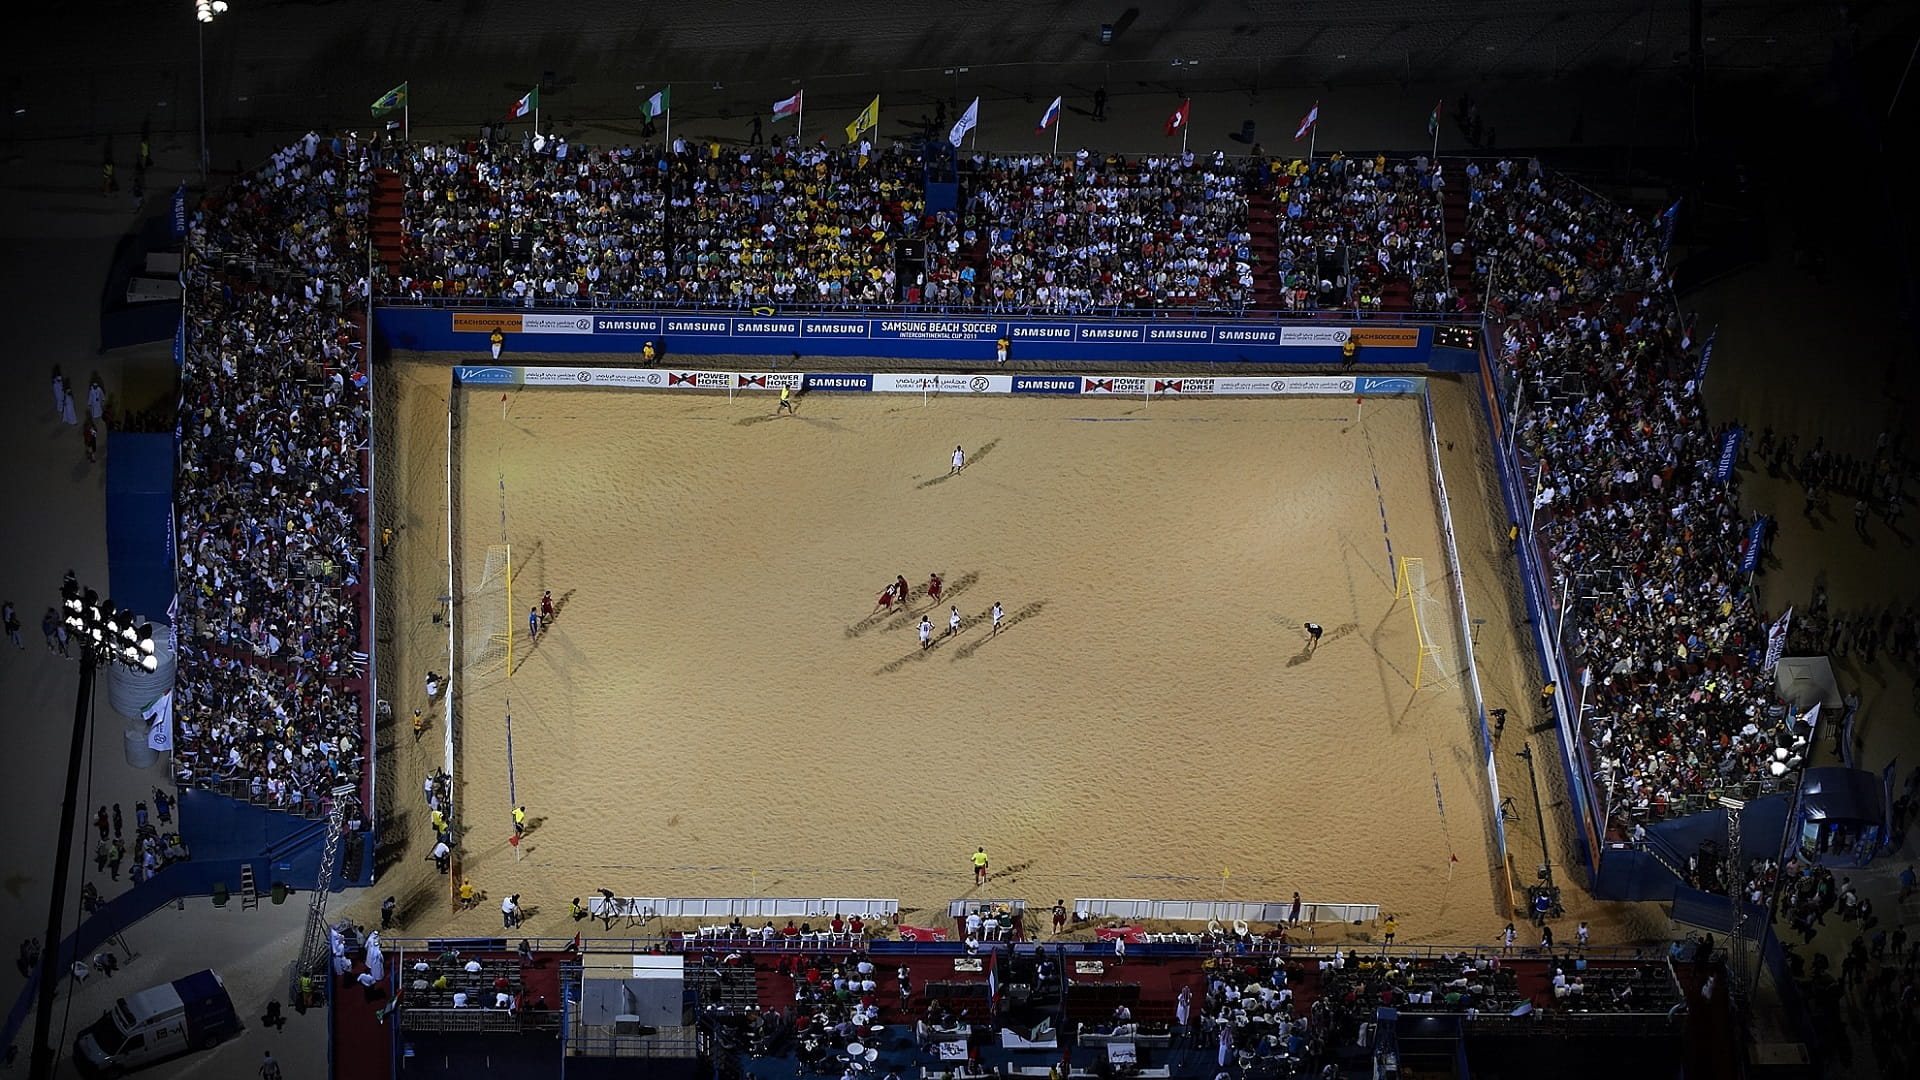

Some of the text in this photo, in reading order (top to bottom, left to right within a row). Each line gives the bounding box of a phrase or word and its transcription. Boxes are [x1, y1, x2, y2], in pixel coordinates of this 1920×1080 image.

[598, 321, 657, 330] SAMSUNG
[668, 322, 726, 331] SAMSUNG
[737, 323, 795, 332] SAMSUNG
[806, 324, 864, 333] SAMSUNG
[881, 322, 997, 333] SAMSUNG BEACH SOCCER
[1013, 328, 1071, 337] SAMSUNG
[1081, 329, 1139, 338] SAMSUNG
[1150, 330, 1208, 339] SAMSUNG
[1219, 331, 1277, 340] SAMSUNG
[809, 378, 867, 387] SAMSUNG
[1017, 381, 1075, 390] SAMSUNG
